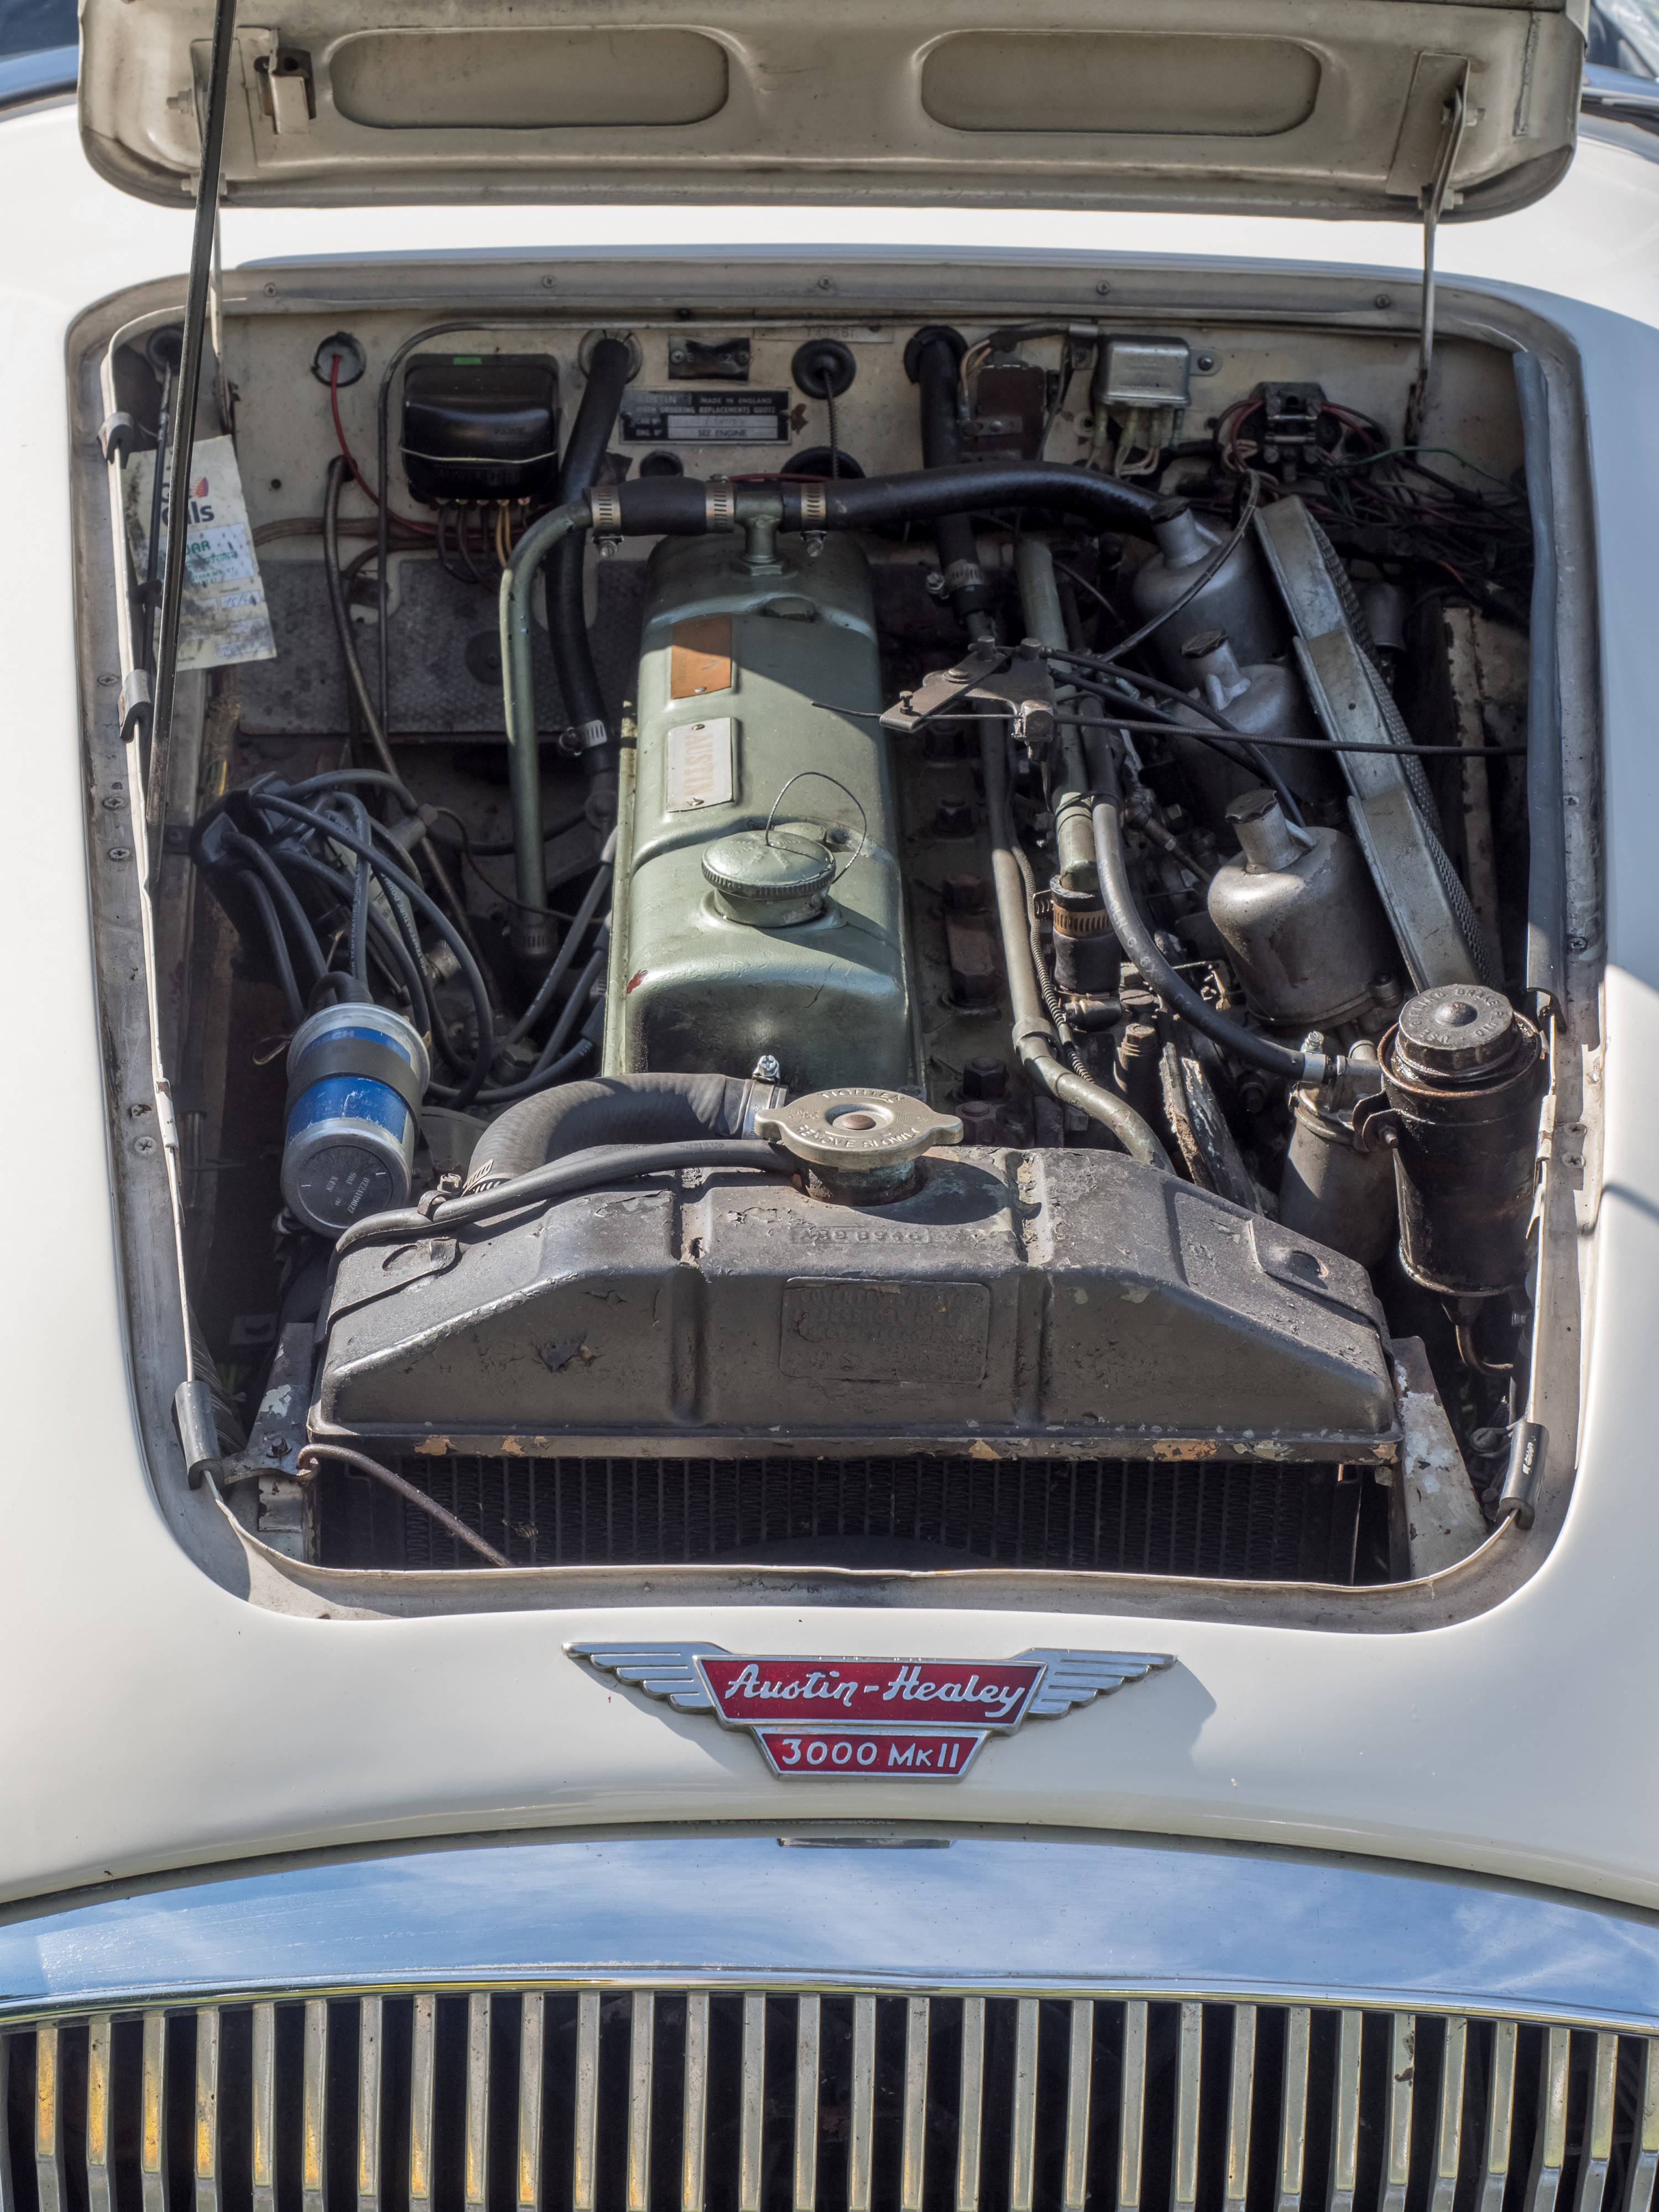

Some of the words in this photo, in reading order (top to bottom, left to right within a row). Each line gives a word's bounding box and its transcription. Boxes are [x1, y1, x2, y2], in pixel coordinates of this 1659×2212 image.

[698, 429, 713, 437] SEE
[714, 429, 748, 437] ENGINE
[684, 733, 715, 797] AUSTIN
[397, 902, 423, 957] TEMPERATURE
[1409, 988, 1446, 1027] GIRLING
[1454, 988, 1500, 1006] BRAKE
[310, 1029, 354, 1050] OSCH
[817, 1087, 905, 1103] TIGHTEN
[797, 1124, 857, 1149] REMOVE
[862, 1127, 921, 1149] SLOWLY
[725, 1663, 1025, 1719] Austin-Healey
[781, 1740, 876, 1766] 3000
